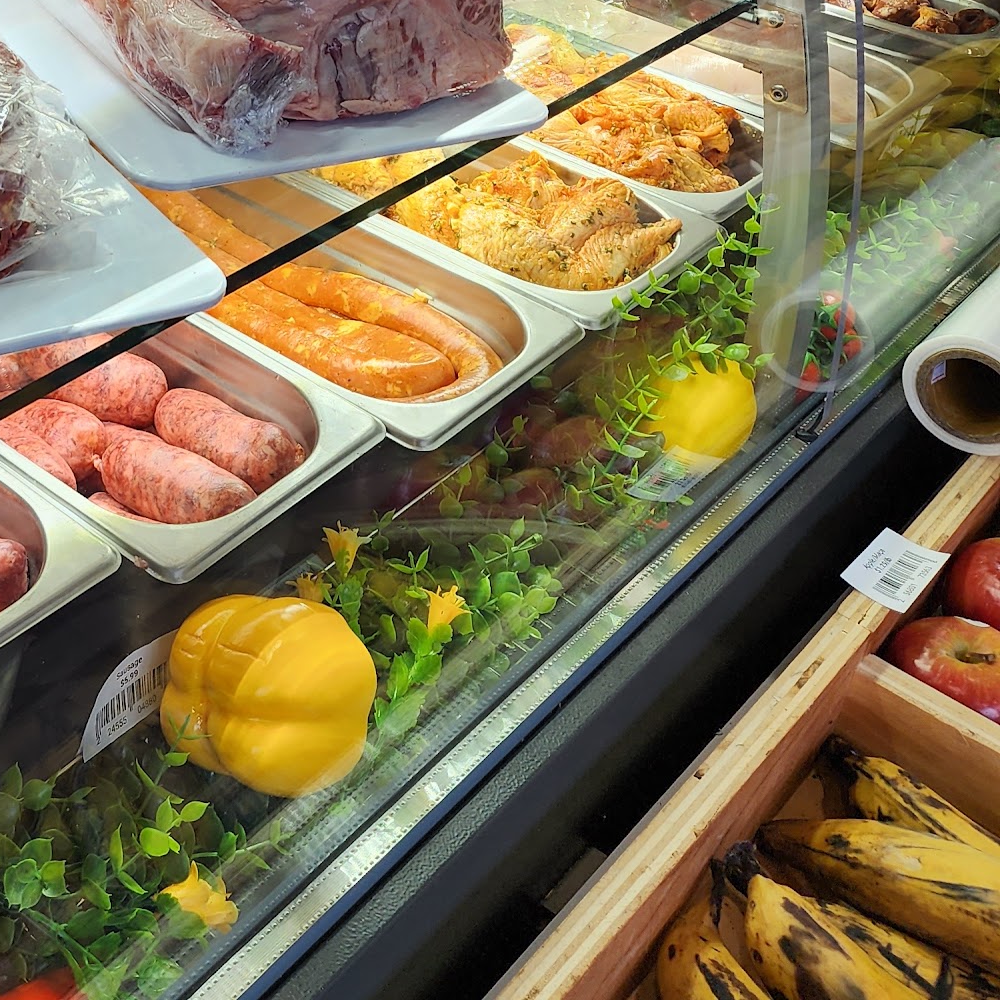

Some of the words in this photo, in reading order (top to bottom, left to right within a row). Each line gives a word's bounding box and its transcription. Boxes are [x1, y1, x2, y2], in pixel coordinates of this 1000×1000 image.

[116, 656, 143, 680] Sausage
[120, 669, 139, 688] $5.99
[107, 717, 128, 737] 24555
